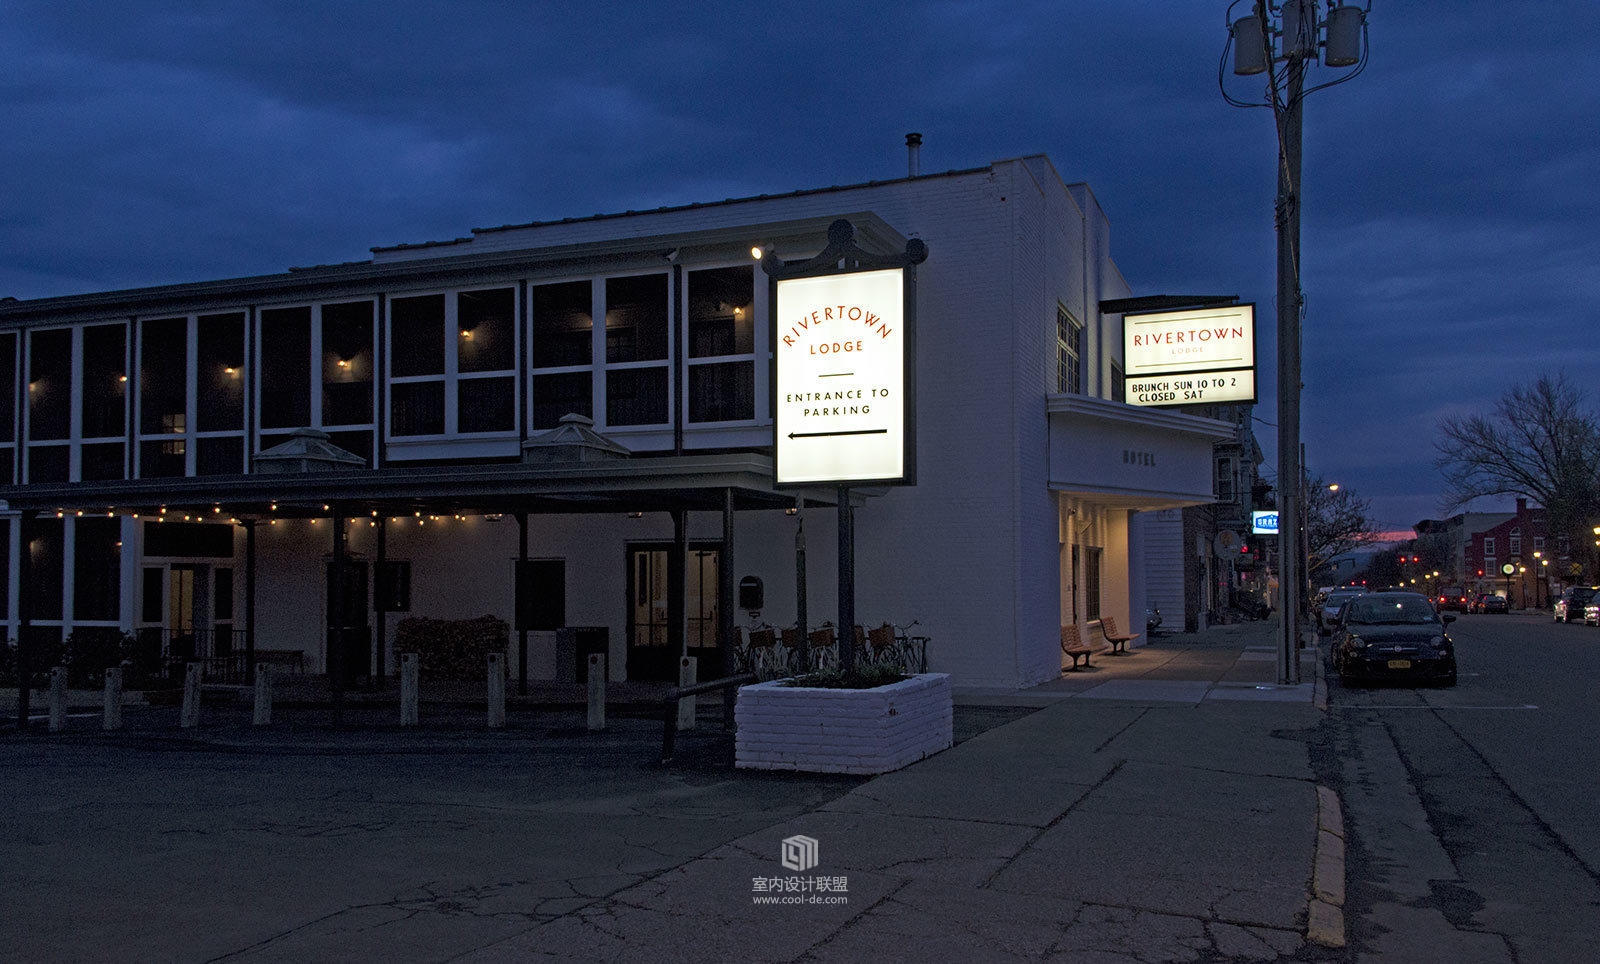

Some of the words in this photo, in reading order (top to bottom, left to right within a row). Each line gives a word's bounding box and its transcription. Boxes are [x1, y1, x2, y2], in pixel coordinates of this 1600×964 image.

[783, 305, 892, 347] RIVERTOWN
[1134, 326, 1243, 347] RIVERTOWN
[810, 340, 863, 355] LODGE
[1171, 346, 1204, 355] LODGE
[1132, 382, 1169, 393] BRUNCH
[1174, 381, 1193, 390] SUN
[1213, 378, 1225, 388] TO
[1231, 377, 1237, 387] 2
[787, 390, 862, 402] ENTRANCE
[872, 388, 889, 397] TO
[1138, 393, 1176, 403] CLOSED
[1184, 390, 1204, 400] SAT
[804, 405, 870, 417] PARKING
[1123, 450, 1156, 467] HOTEL
